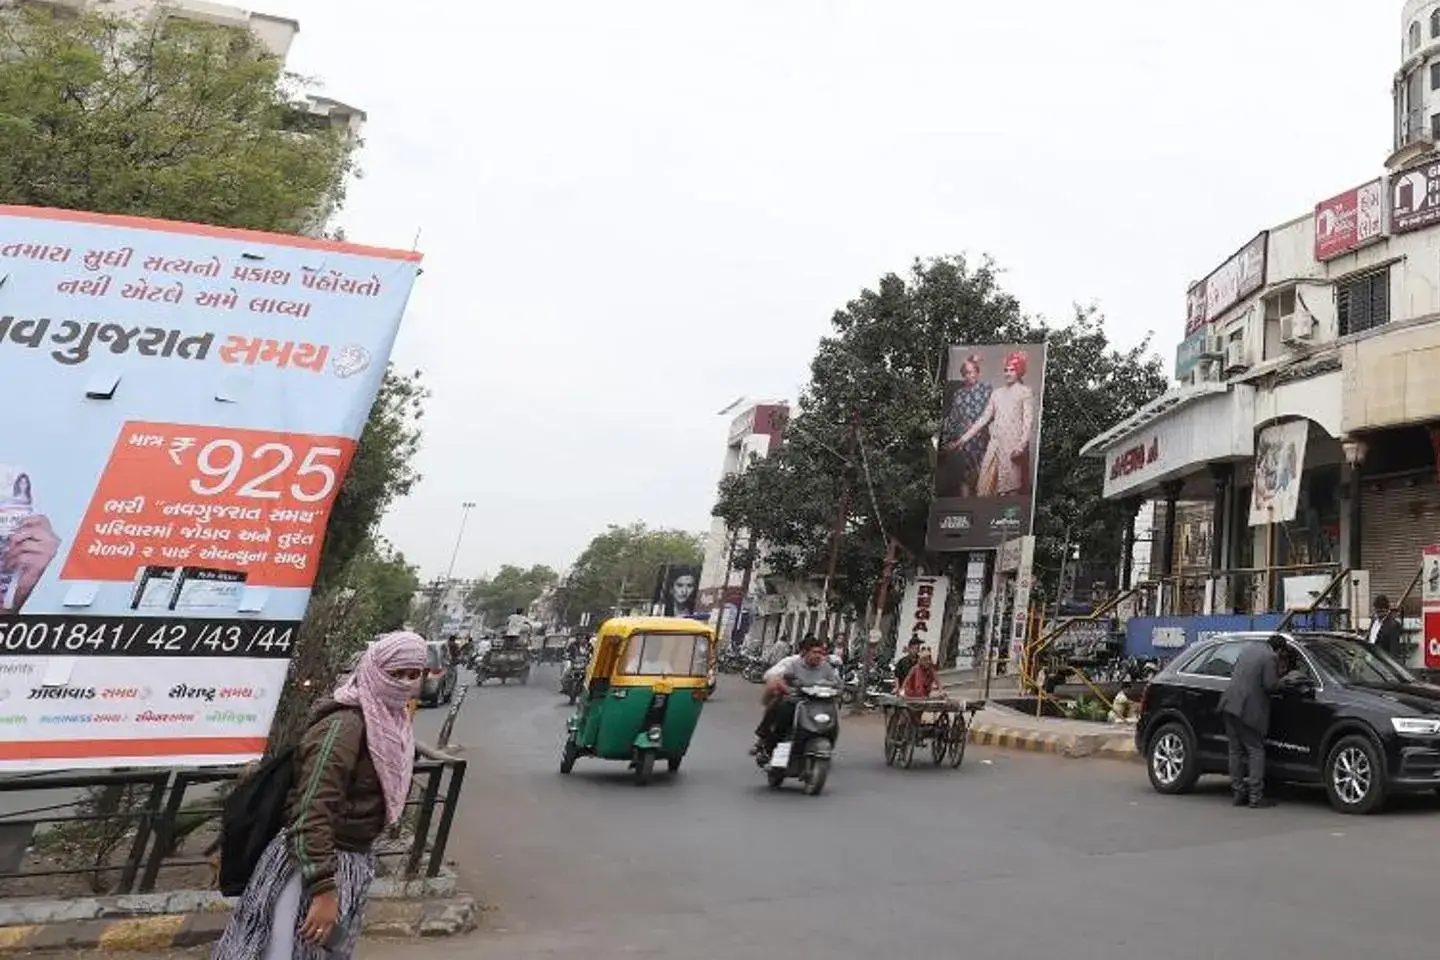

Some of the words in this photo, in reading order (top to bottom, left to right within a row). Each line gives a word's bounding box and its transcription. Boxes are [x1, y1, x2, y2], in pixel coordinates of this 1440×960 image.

[1, 243, 72, 262] તમારા
[83, 247, 134, 271] સુધી
[143, 255, 221, 277] સત્યનો
[231, 265, 291, 286] પ્રકાશ
[57, 275, 112, 297] નથી
[120, 278, 184, 304] એટલે
[194, 287, 239, 310] અમે
[249, 296, 311, 318] લાવ્યા
[218, 335, 330, 373] સમય
[238, 527, 272, 544] અને
[147, 625, 187, 651] 42
